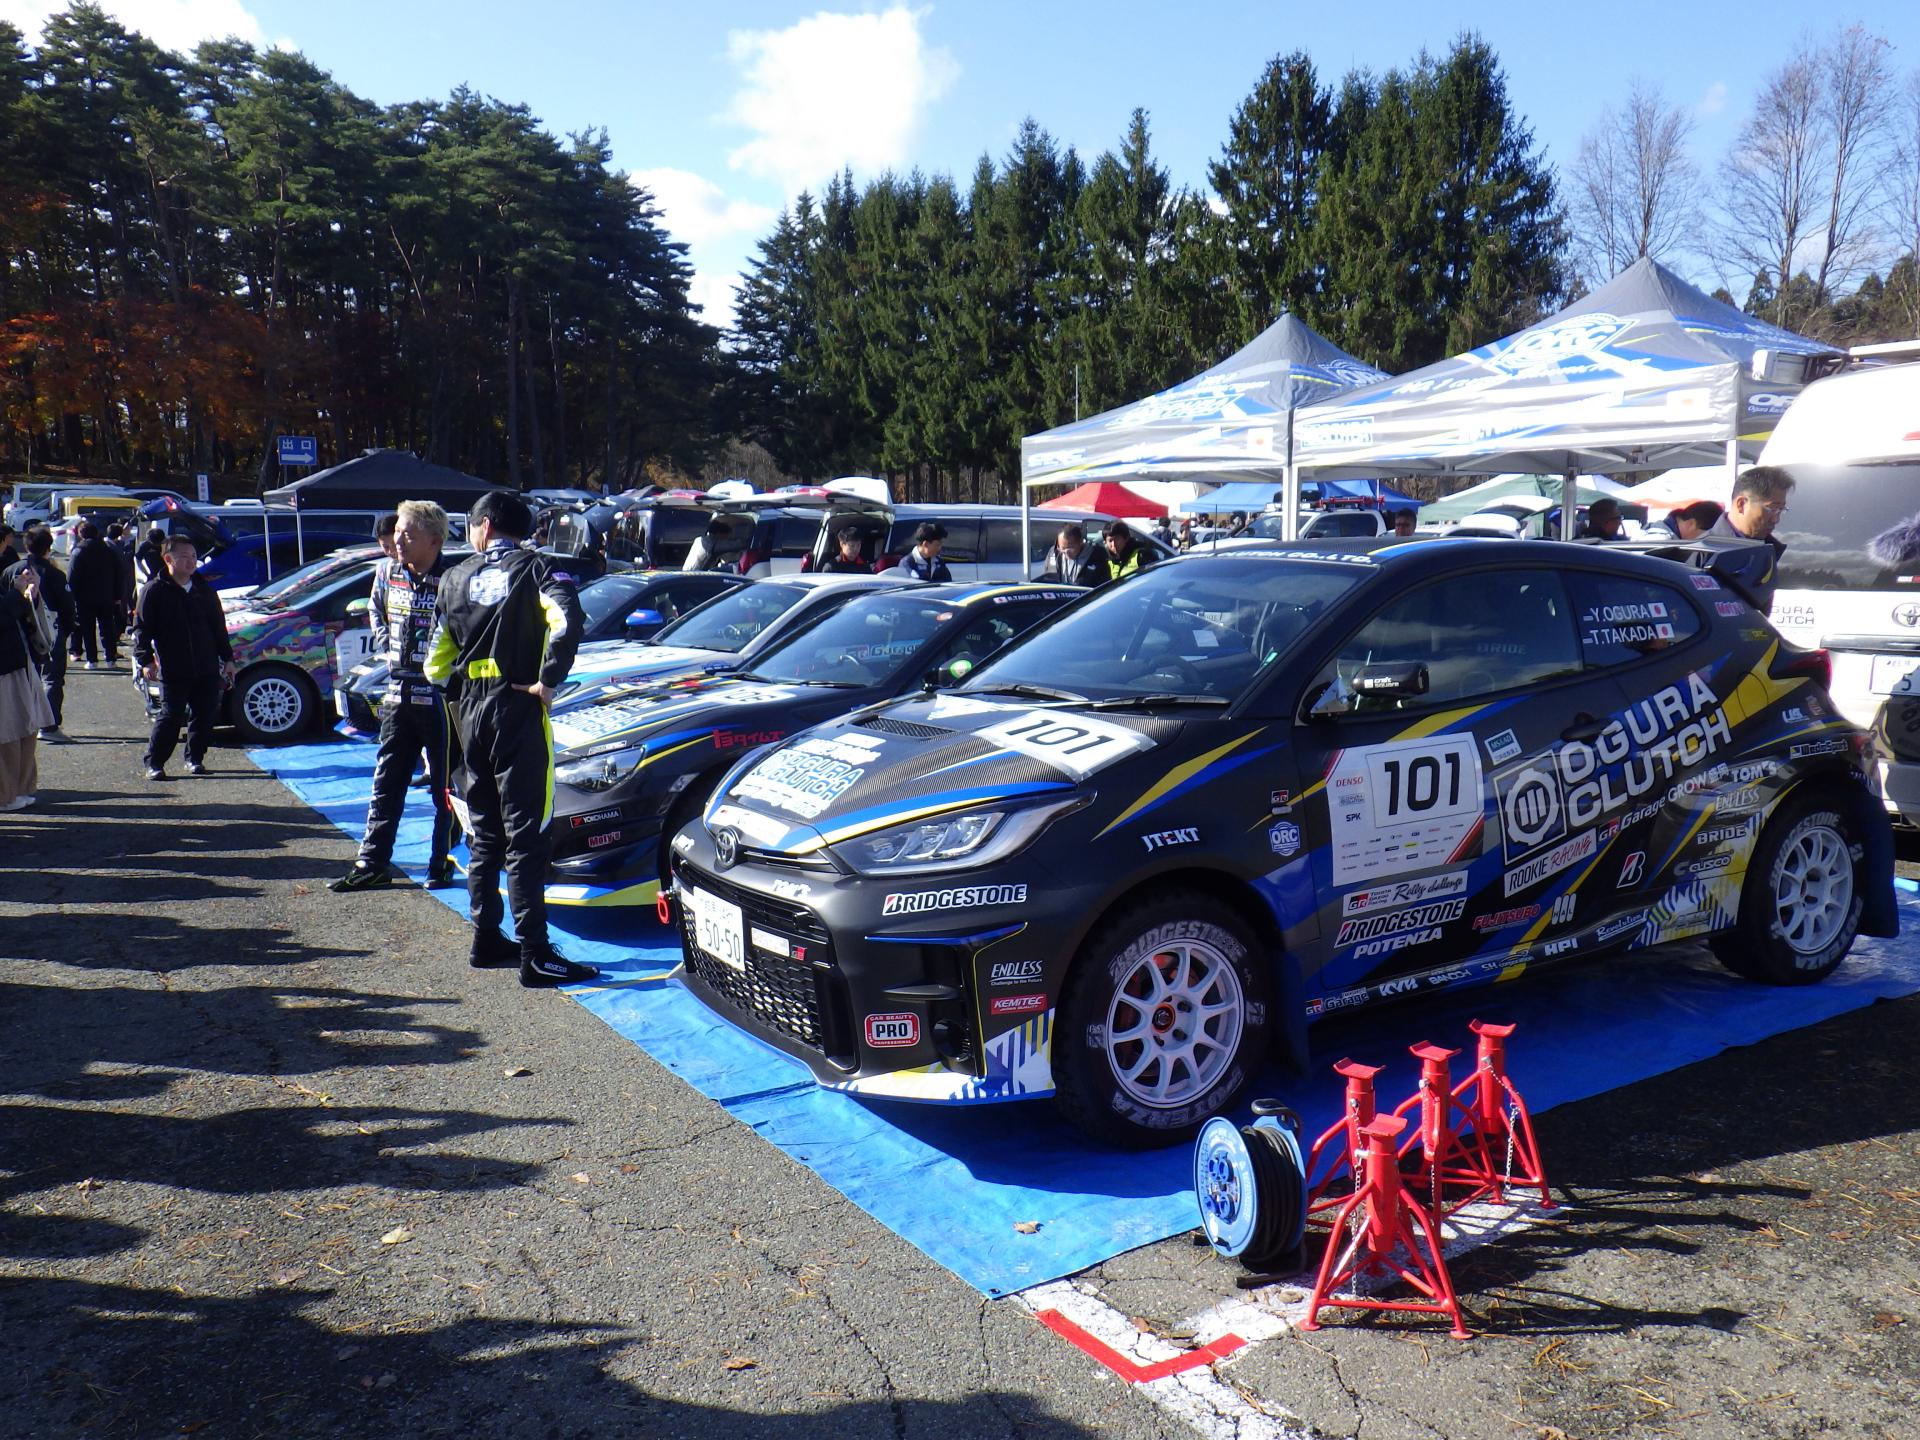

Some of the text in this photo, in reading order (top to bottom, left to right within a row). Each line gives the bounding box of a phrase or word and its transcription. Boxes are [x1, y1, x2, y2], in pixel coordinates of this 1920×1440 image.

[282, 439, 312, 450] 出口
[1590, 604, 1650, 623] Y.OGURA
[1590, 625, 1657, 645] T.TAKADA
[1006, 719, 1115, 755] 101
[1560, 671, 1718, 784] OGURA
[786, 752, 865, 788] OGURA
[1569, 708, 1732, 827] CLUTCH
[1730, 760, 1777, 782] TOM'S
[767, 766, 852, 802] CLUTCH
[1336, 776, 1363, 787] DENSO
[1384, 752, 1460, 816] 101
[1621, 796, 1666, 830] Garage
[1667, 771, 1708, 802] GROW
[1716, 787, 1760, 810] ENDLESS
[583, 810, 619, 823] YOKOHAMA
[1142, 827, 1200, 852] JTEKT
[1271, 829, 1298, 844] ORC
[1697, 825, 1747, 845] BRIDE
[1509, 836, 1592, 891] ROOKIE RACING
[883, 884, 1028, 916] BRIDGESTONE
[1393, 877, 1463, 901] Rally challenge
[1334, 897, 1468, 949] BRIDGESTONE
[1472, 904, 1541, 930] FUJITSUBO
[1596, 909, 1648, 936] Revolution
[705, 917, 741, 963] 50-50
[1353, 926, 1443, 959] POTENZA
[991, 960, 1044, 977] ENDLESS
[875, 1022, 908, 1038] PRO
